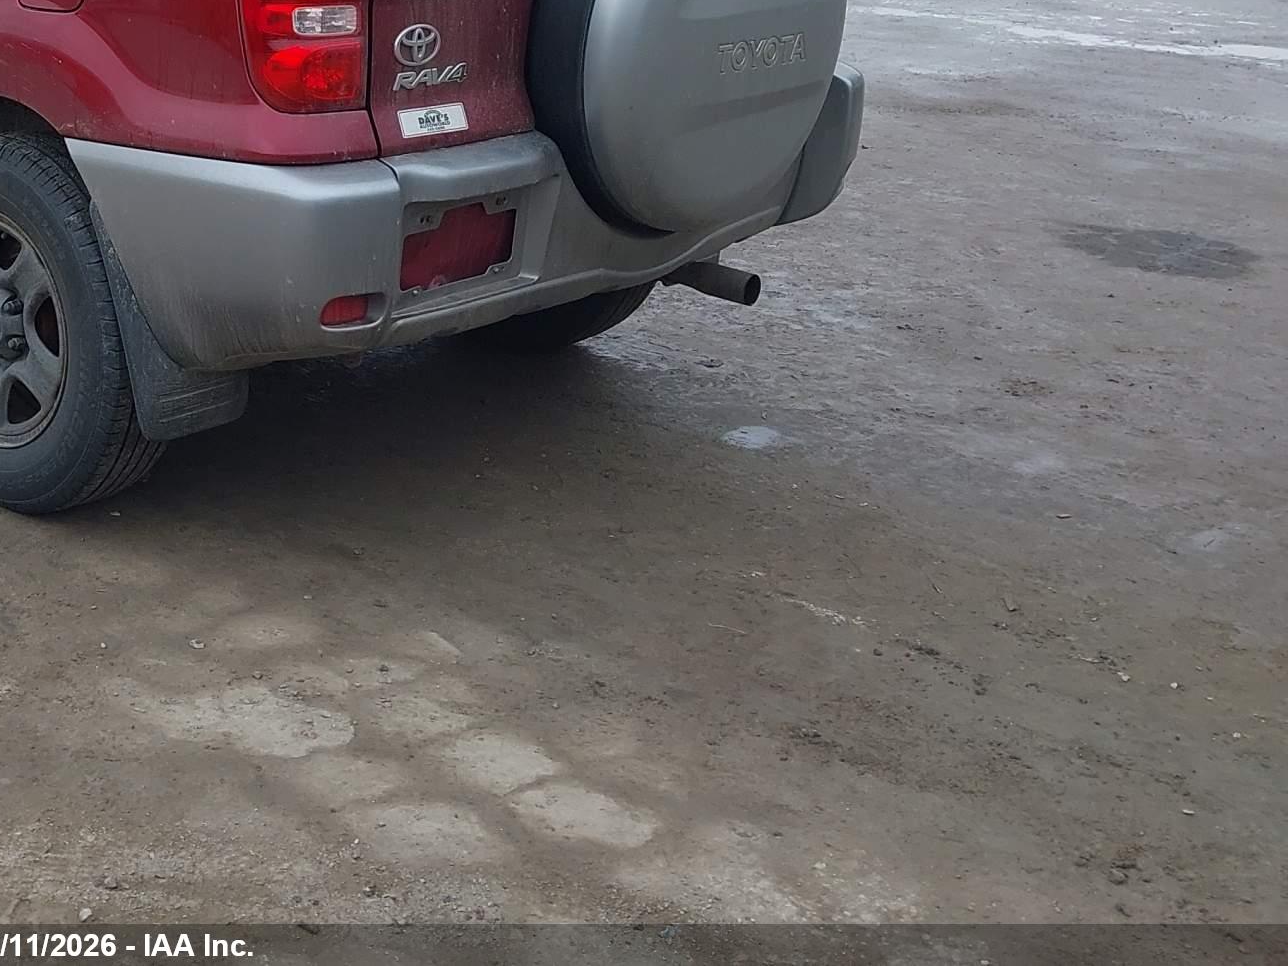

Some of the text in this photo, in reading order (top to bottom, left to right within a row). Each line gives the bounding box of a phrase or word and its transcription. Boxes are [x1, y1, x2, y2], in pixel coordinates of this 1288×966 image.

[718, 32, 807, 75] TOYOTA
[392, 62, 468, 91] RAV4
[417, 113, 449, 125] DAVE'S
